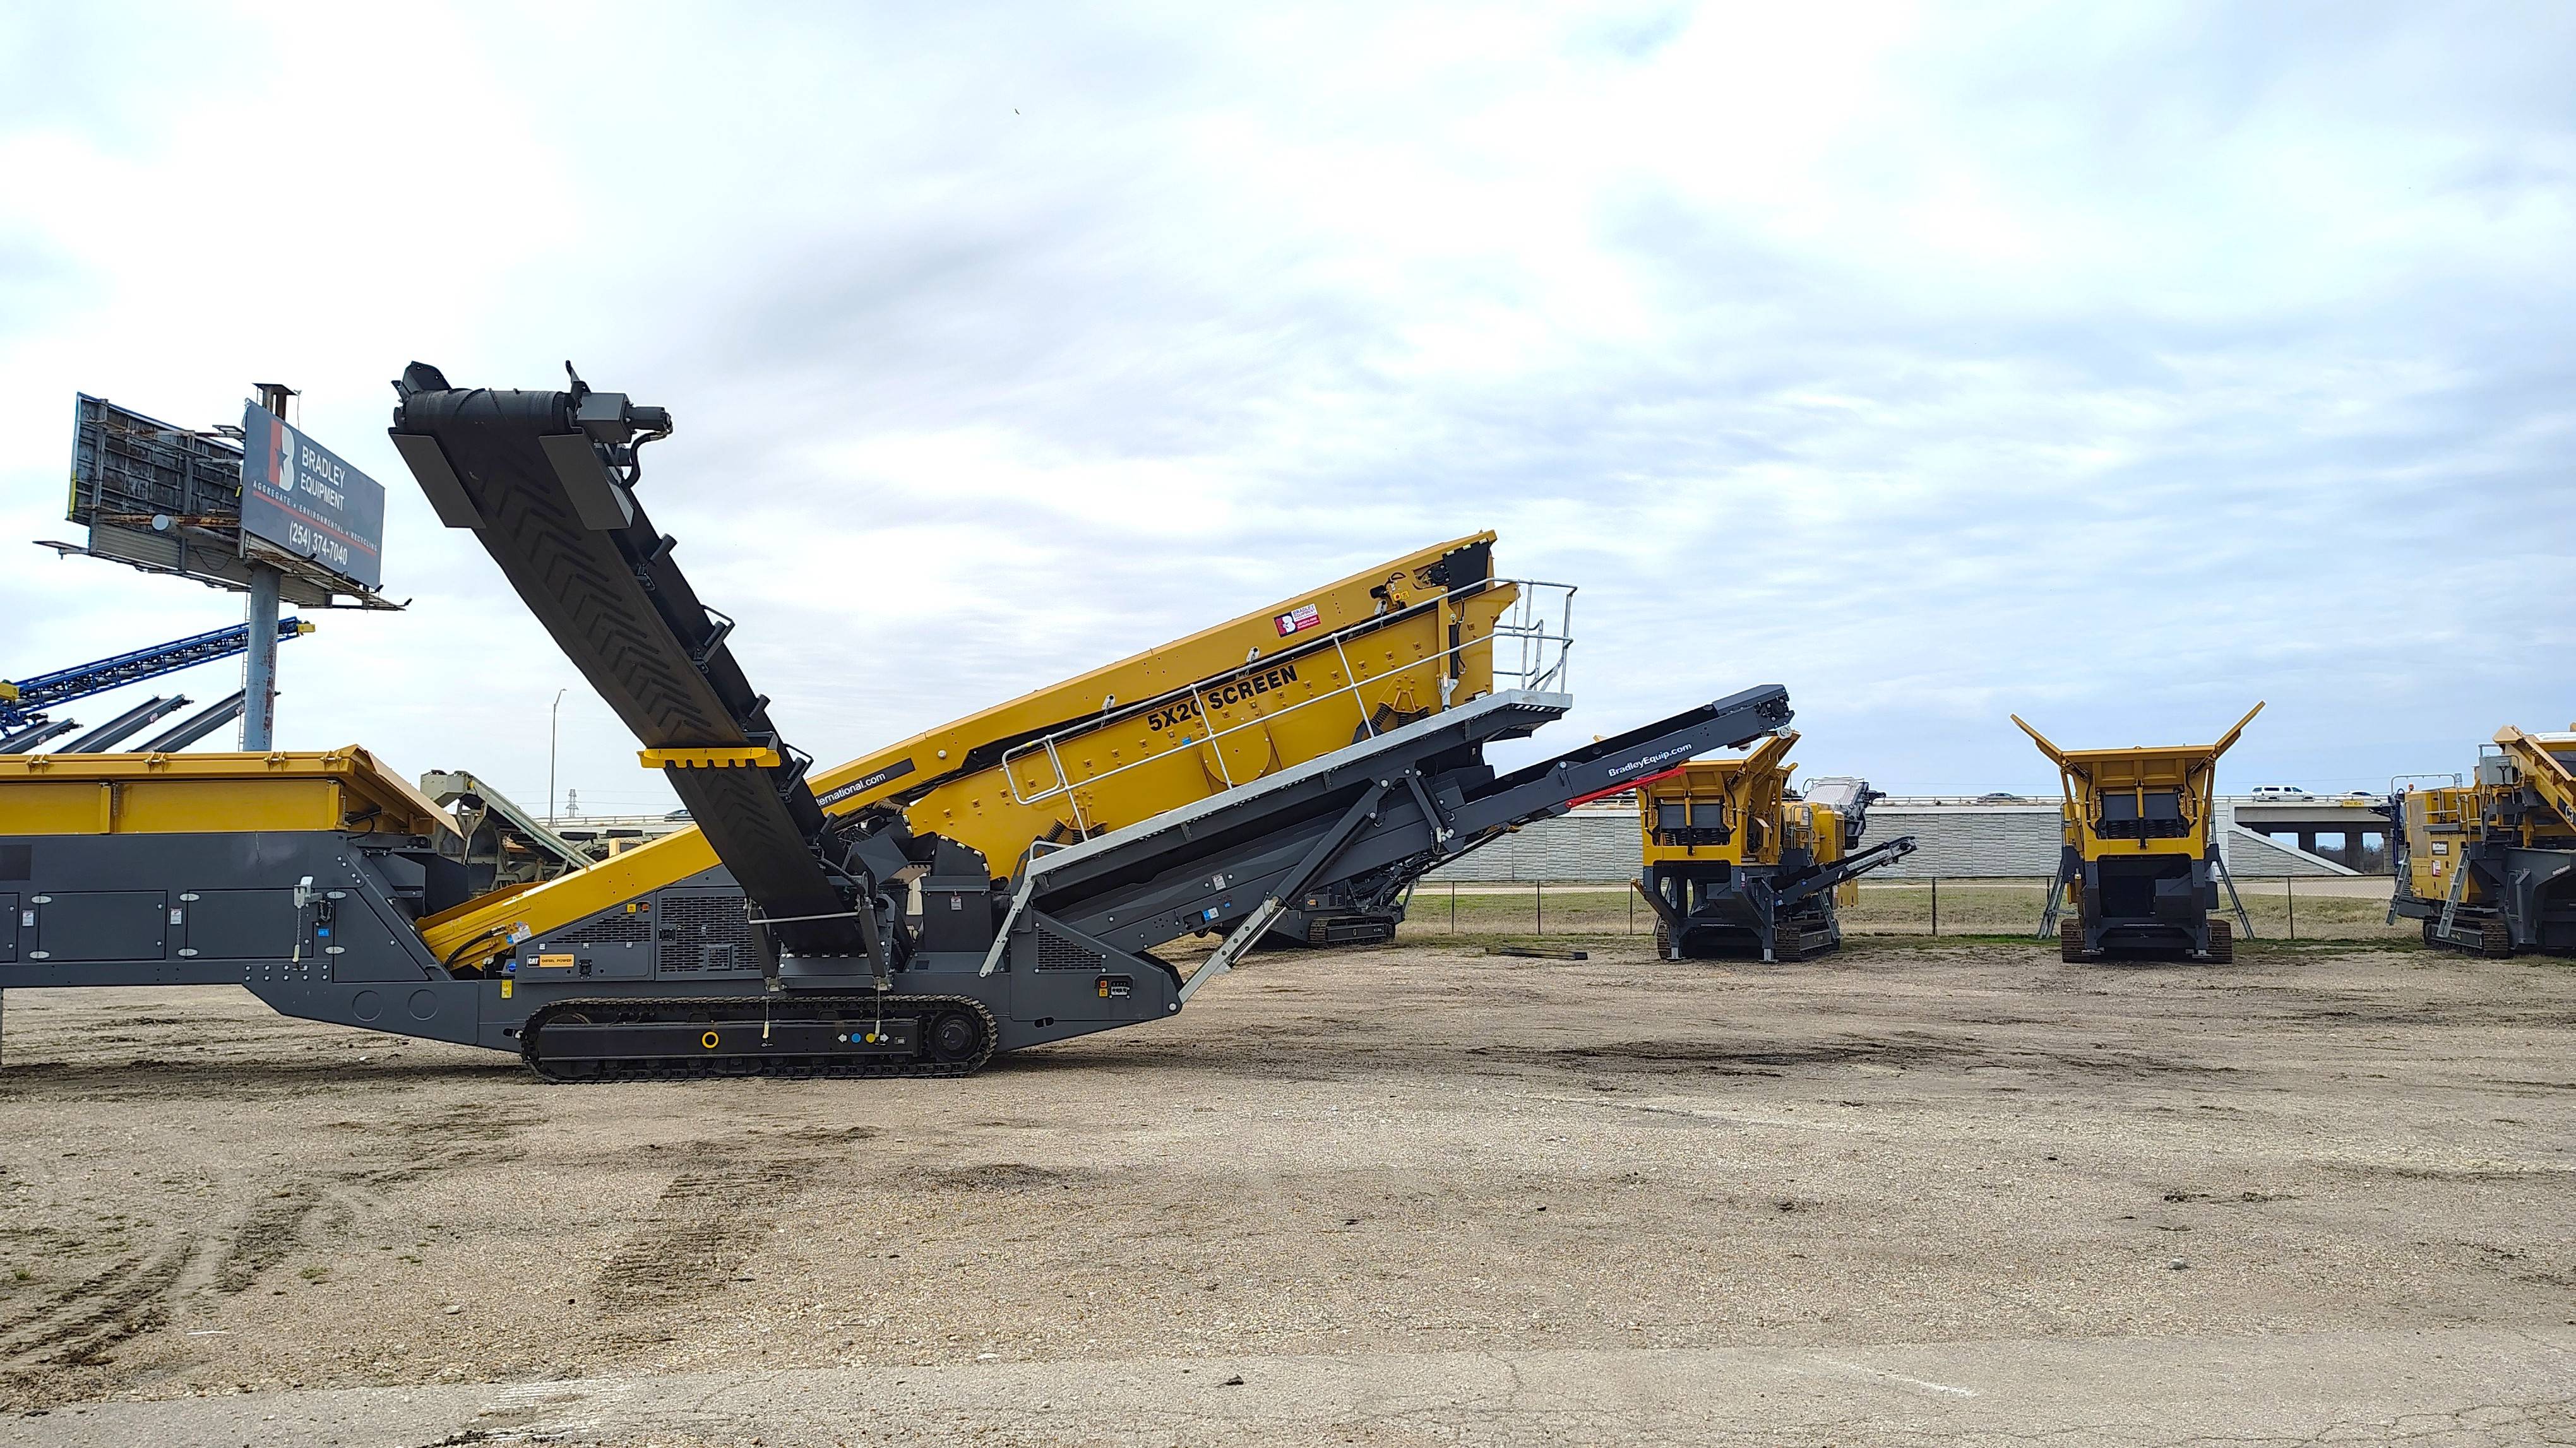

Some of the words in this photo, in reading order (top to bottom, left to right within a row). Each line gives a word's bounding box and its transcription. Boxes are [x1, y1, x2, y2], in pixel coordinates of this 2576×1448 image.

[302, 445, 345, 489] BRADLEY
[301, 472, 345, 511] EQUIPMENT
[253, 480, 291, 506] AGGREGATE
[299, 504, 344, 534] ENVIRONMENTAL
[350, 531, 378, 552] RECYCLING
[289, 520, 311, 553] (254)
[312, 532, 348, 566] 374-7040
[1147, 700, 1205, 732] 5X20
[1208, 665, 1298, 709] SCREEN
[1608, 743, 1693, 777] BradleyEquip.com
